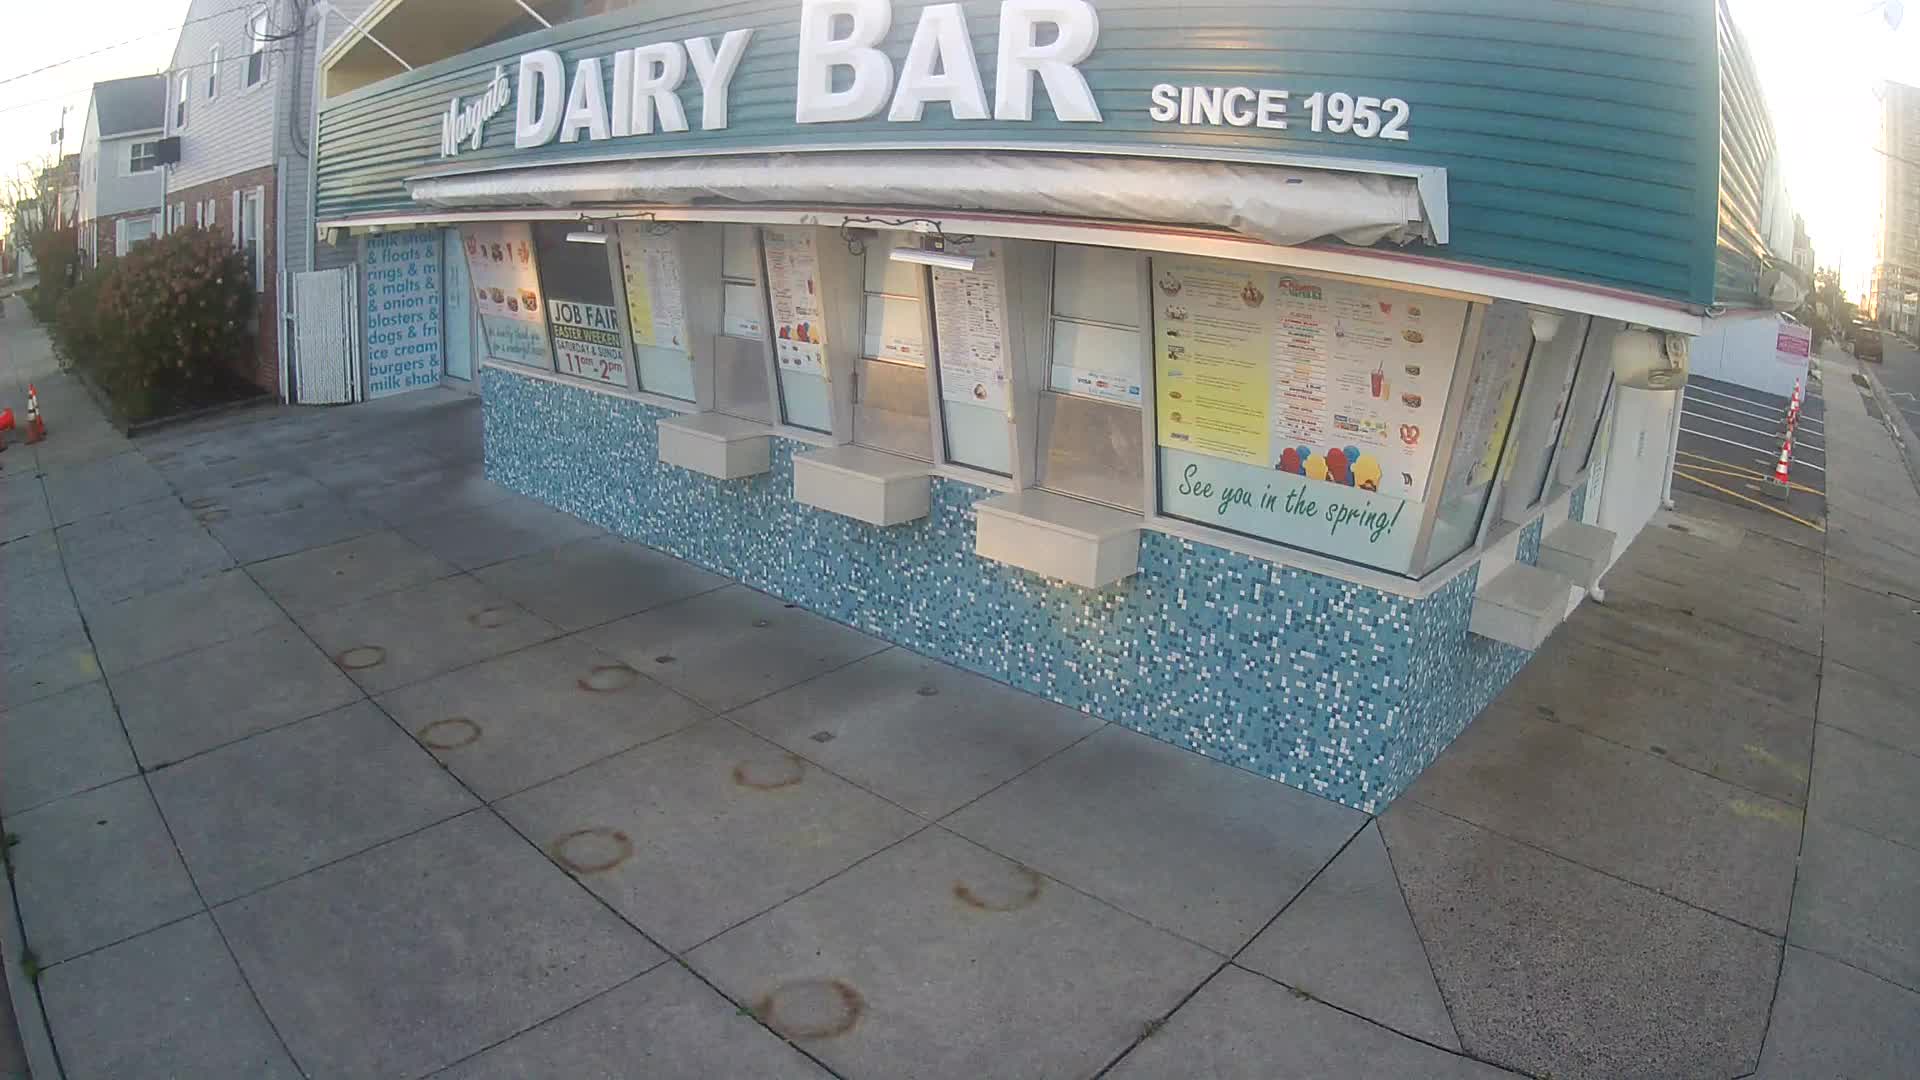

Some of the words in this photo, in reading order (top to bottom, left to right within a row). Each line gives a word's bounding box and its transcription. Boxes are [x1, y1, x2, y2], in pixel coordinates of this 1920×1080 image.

[441, 64, 511, 159] Margate
[515, 28, 754, 149] DAIRY
[796, 0, 1103, 124] BAR
[1149, 83, 1289, 130] SINCE
[1303, 92, 1410, 141] 1952
[368, 250, 377, 265] &
[382, 246, 421, 263] floats
[368, 265, 402, 282] rings
[407, 262, 417, 276] &
[368, 282, 377, 297] &
[383, 279, 421, 294] malts
[425, 276, 435, 289] &
[368, 299, 377, 312] &
[383, 294, 424, 310] onion
[369, 311, 424, 328] blasters
[429, 307, 438, 321] &
[555, 303, 582, 324] JOB
[586, 306, 618, 331] FAIR
[369, 330, 402, 345] dogs
[407, 324, 417, 338] &
[423, 321, 437, 337] fri
[554, 325, 584, 342] EASTER
[369, 346, 389, 360] ice
[394, 341, 438, 356] cream
[369, 356, 425, 376] burgers
[429, 353, 439, 367] &
[566, 352, 593, 375] 11am
[600, 359, 623, 380] 2pm
[370, 374, 401, 392] milk
[1178, 463, 1214, 497] See
[1217, 483, 1252, 516] you
[1260, 484, 1277, 513] in
[1284, 485, 1319, 517] the
[1324, 499, 1406, 544] spring!
